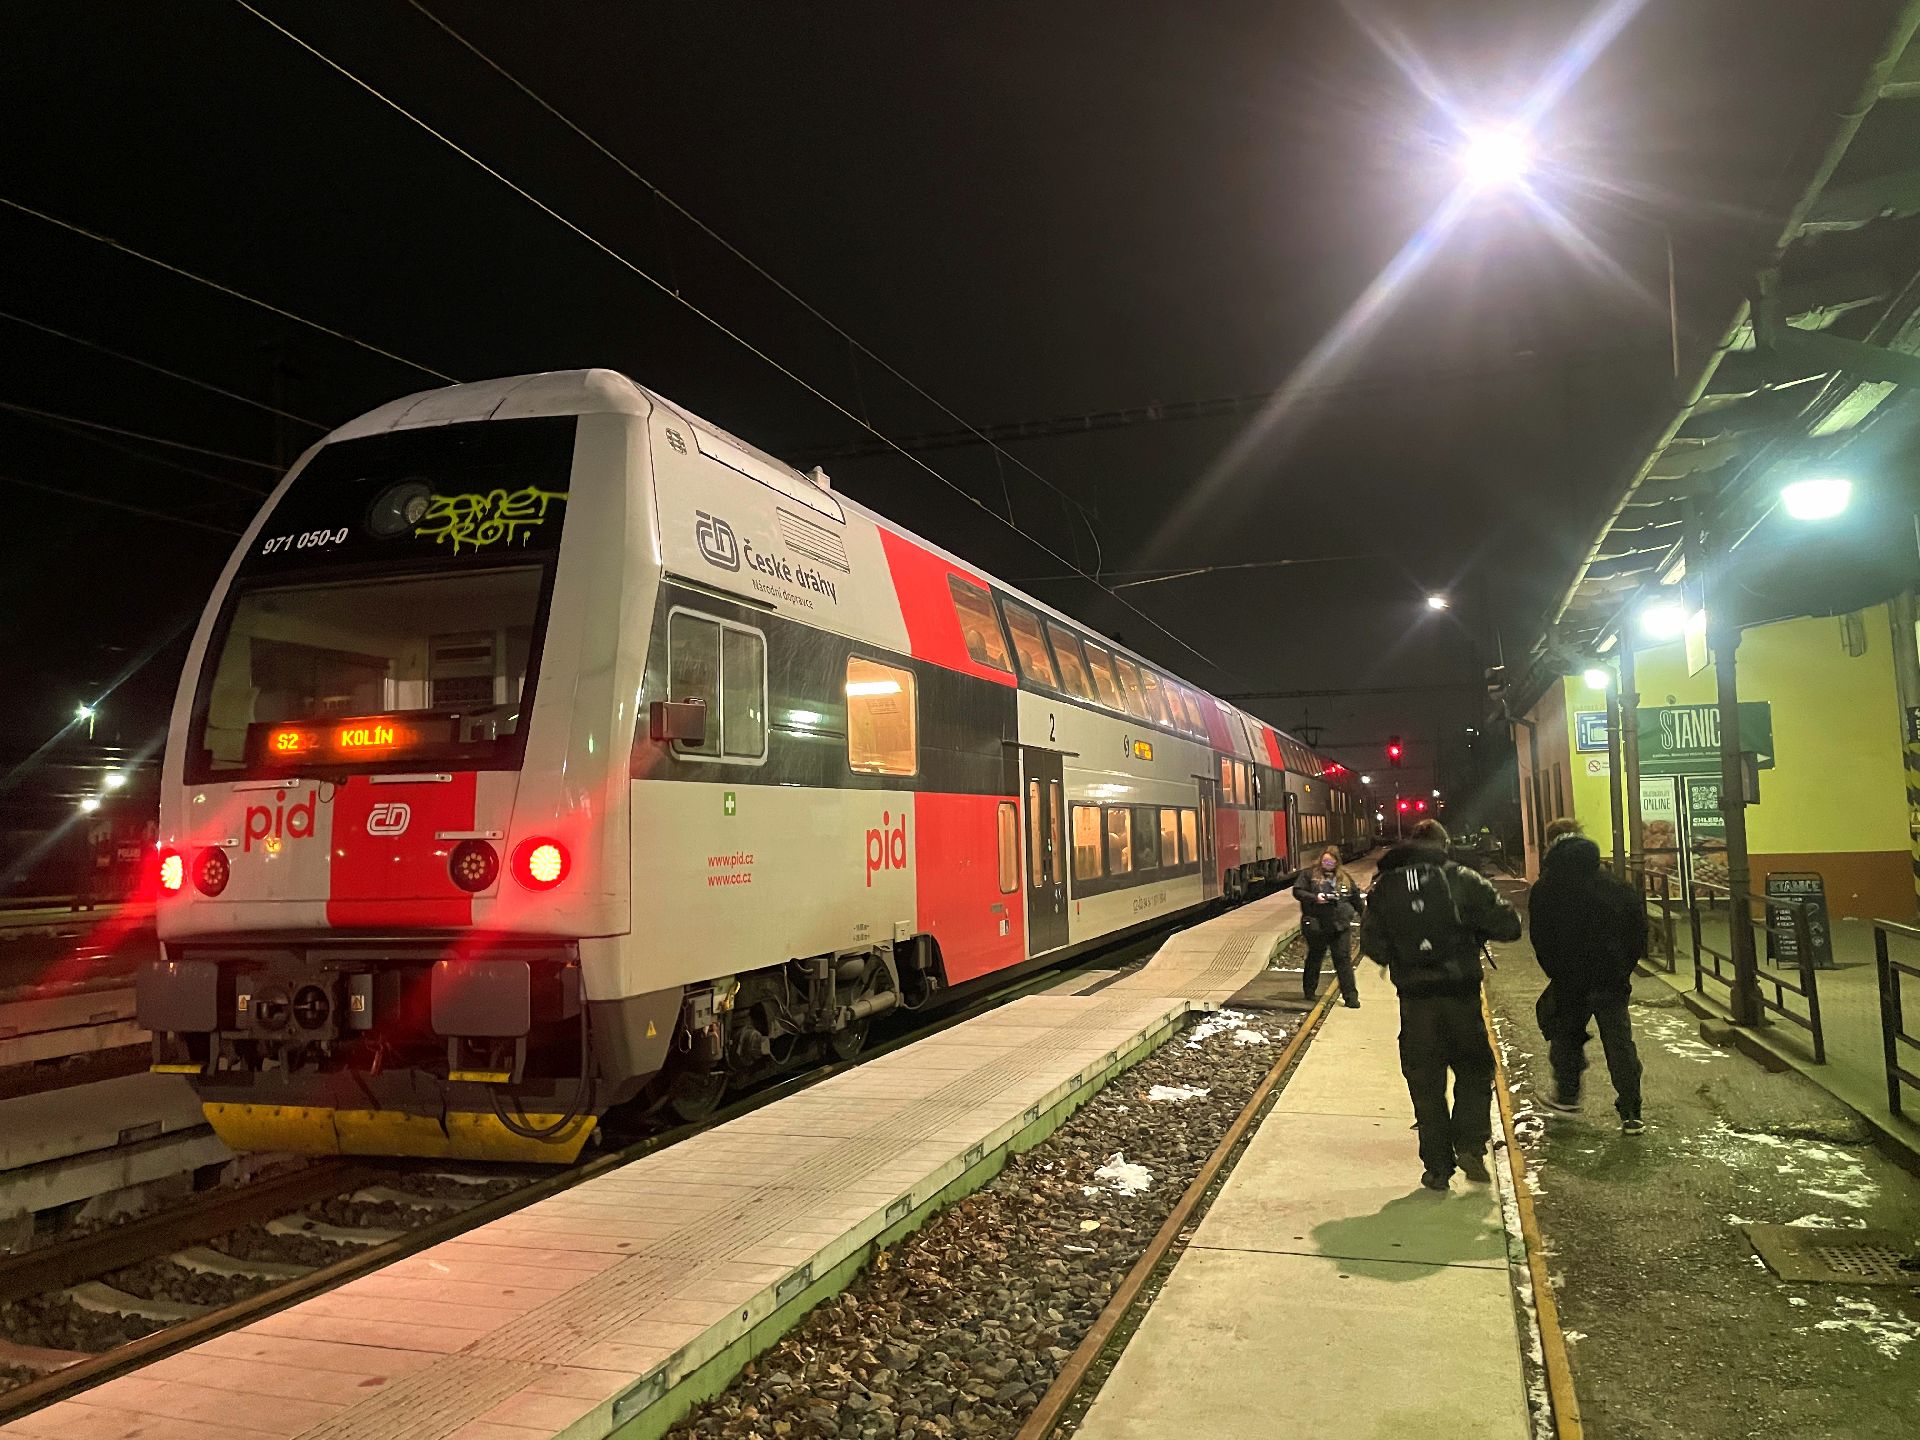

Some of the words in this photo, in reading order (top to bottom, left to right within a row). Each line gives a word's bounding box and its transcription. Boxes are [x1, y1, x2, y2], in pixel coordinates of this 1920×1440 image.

[262, 534, 295, 555] 971
[296, 527, 349, 549] 050-0
[743, 537, 794, 584] České
[795, 564, 838, 606] dráhy
[277, 733, 299, 750] S2
[341, 726, 393, 747] KOLÍN
[1049, 713, 1056, 742] 2
[1659, 708, 1721, 750] STANIC
[243, 790, 316, 853] pid
[707, 851, 754, 868] www.pid.cz
[866, 810, 907, 888] pid
